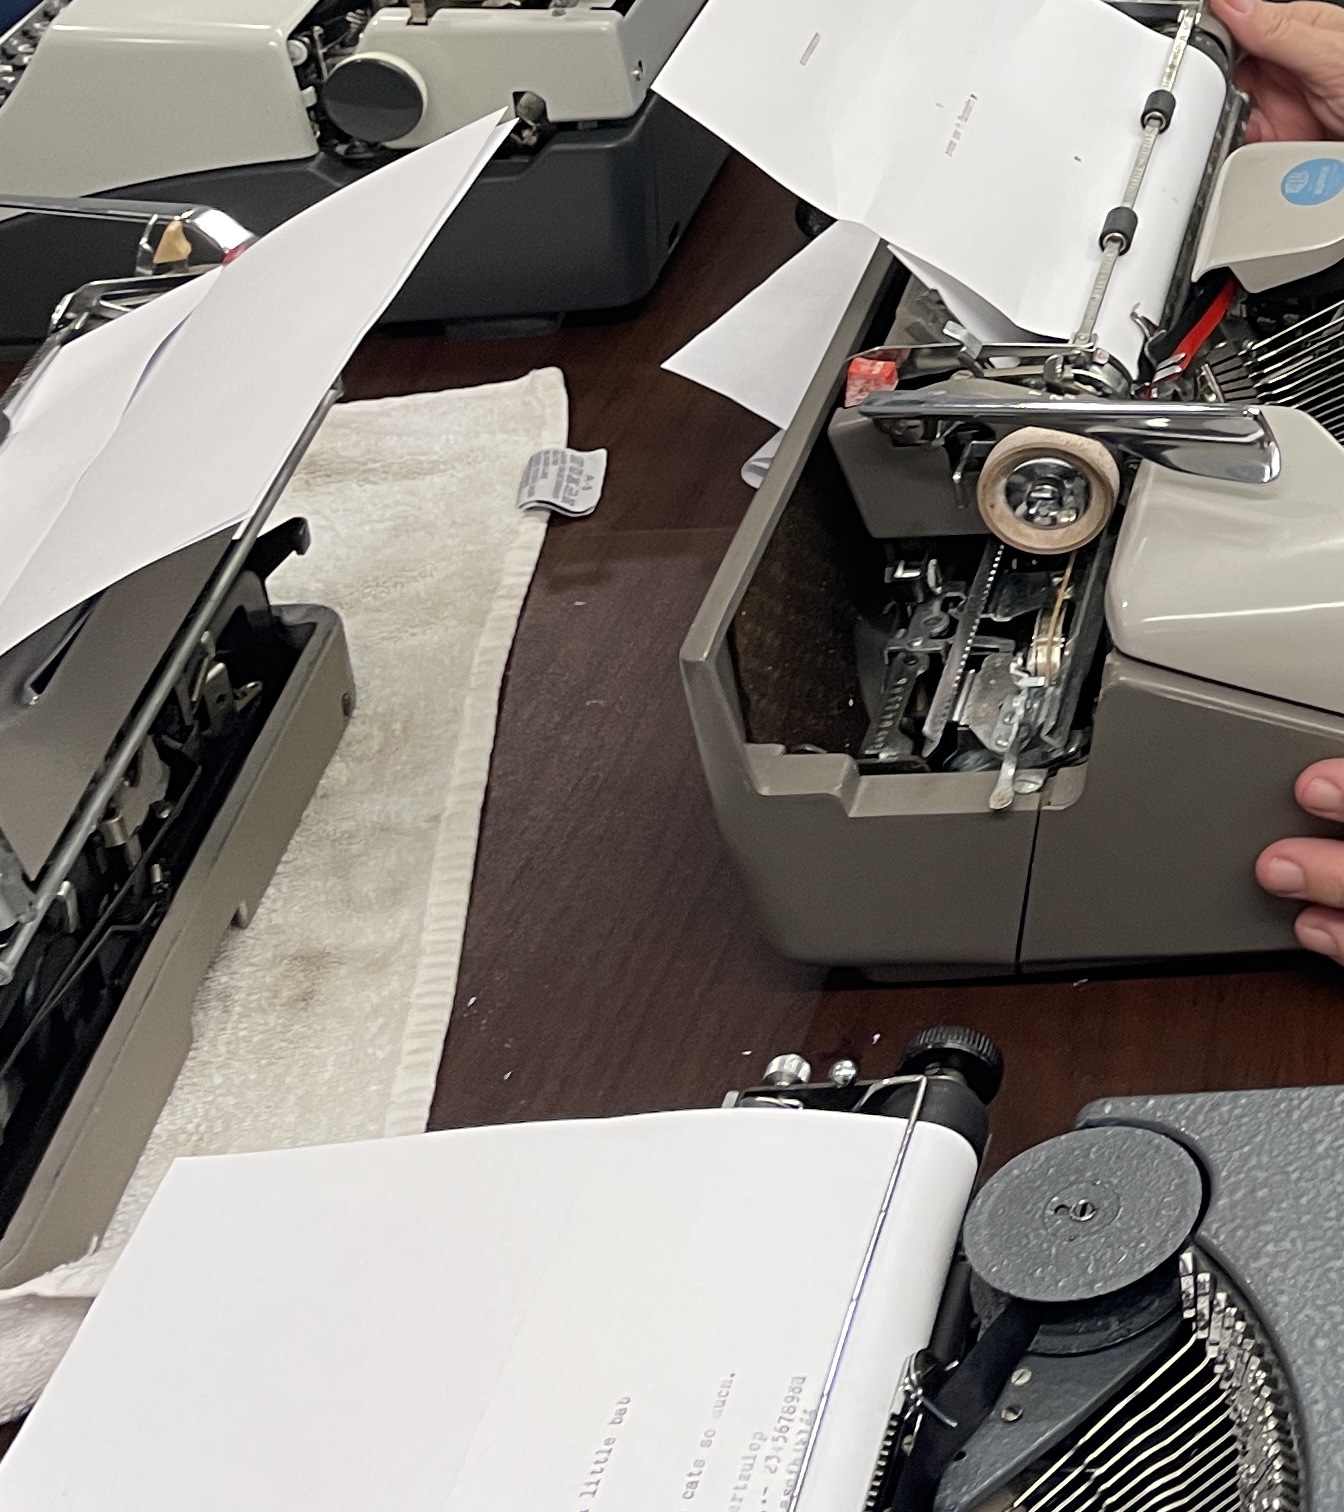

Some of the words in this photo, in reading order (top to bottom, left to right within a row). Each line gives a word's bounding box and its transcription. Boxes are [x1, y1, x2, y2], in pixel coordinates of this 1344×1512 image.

[579, 1437, 617, 1498] little
[681, 1458, 706, 1500] cats
[699, 1428, 717, 1449] so
